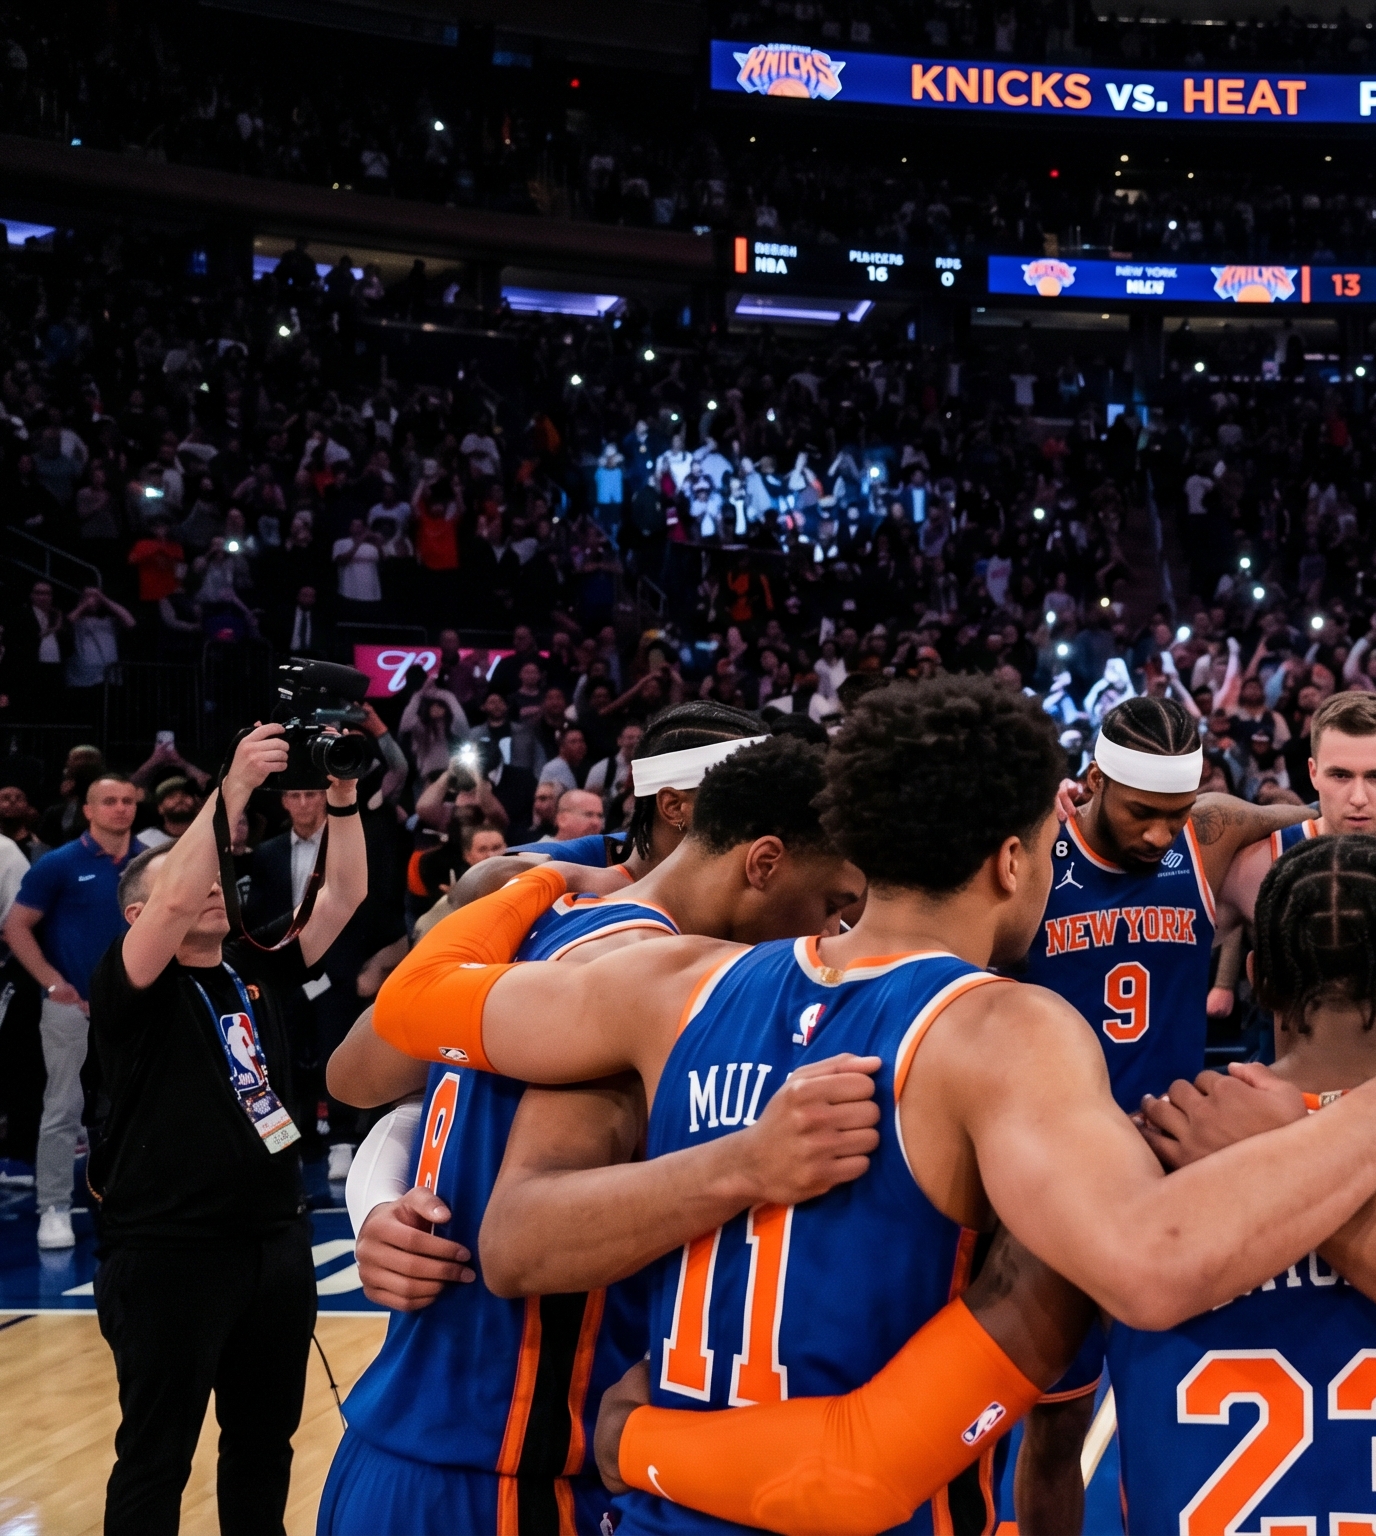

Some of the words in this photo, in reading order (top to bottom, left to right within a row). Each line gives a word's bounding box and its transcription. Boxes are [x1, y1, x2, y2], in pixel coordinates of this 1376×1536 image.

[911, 63, 1092, 110] KNICKS
[1105, 82, 1168, 113] vs.
[1183, 77, 1307, 116] HEAT
[866, 264, 889, 282] 16
[1331, 273, 1361, 297] 13
[1045, 908, 1120, 958] NEW
[1122, 905, 1197, 946] YORK
[1102, 960, 1151, 1044] 9
[660, 1203, 795, 1408] 11
